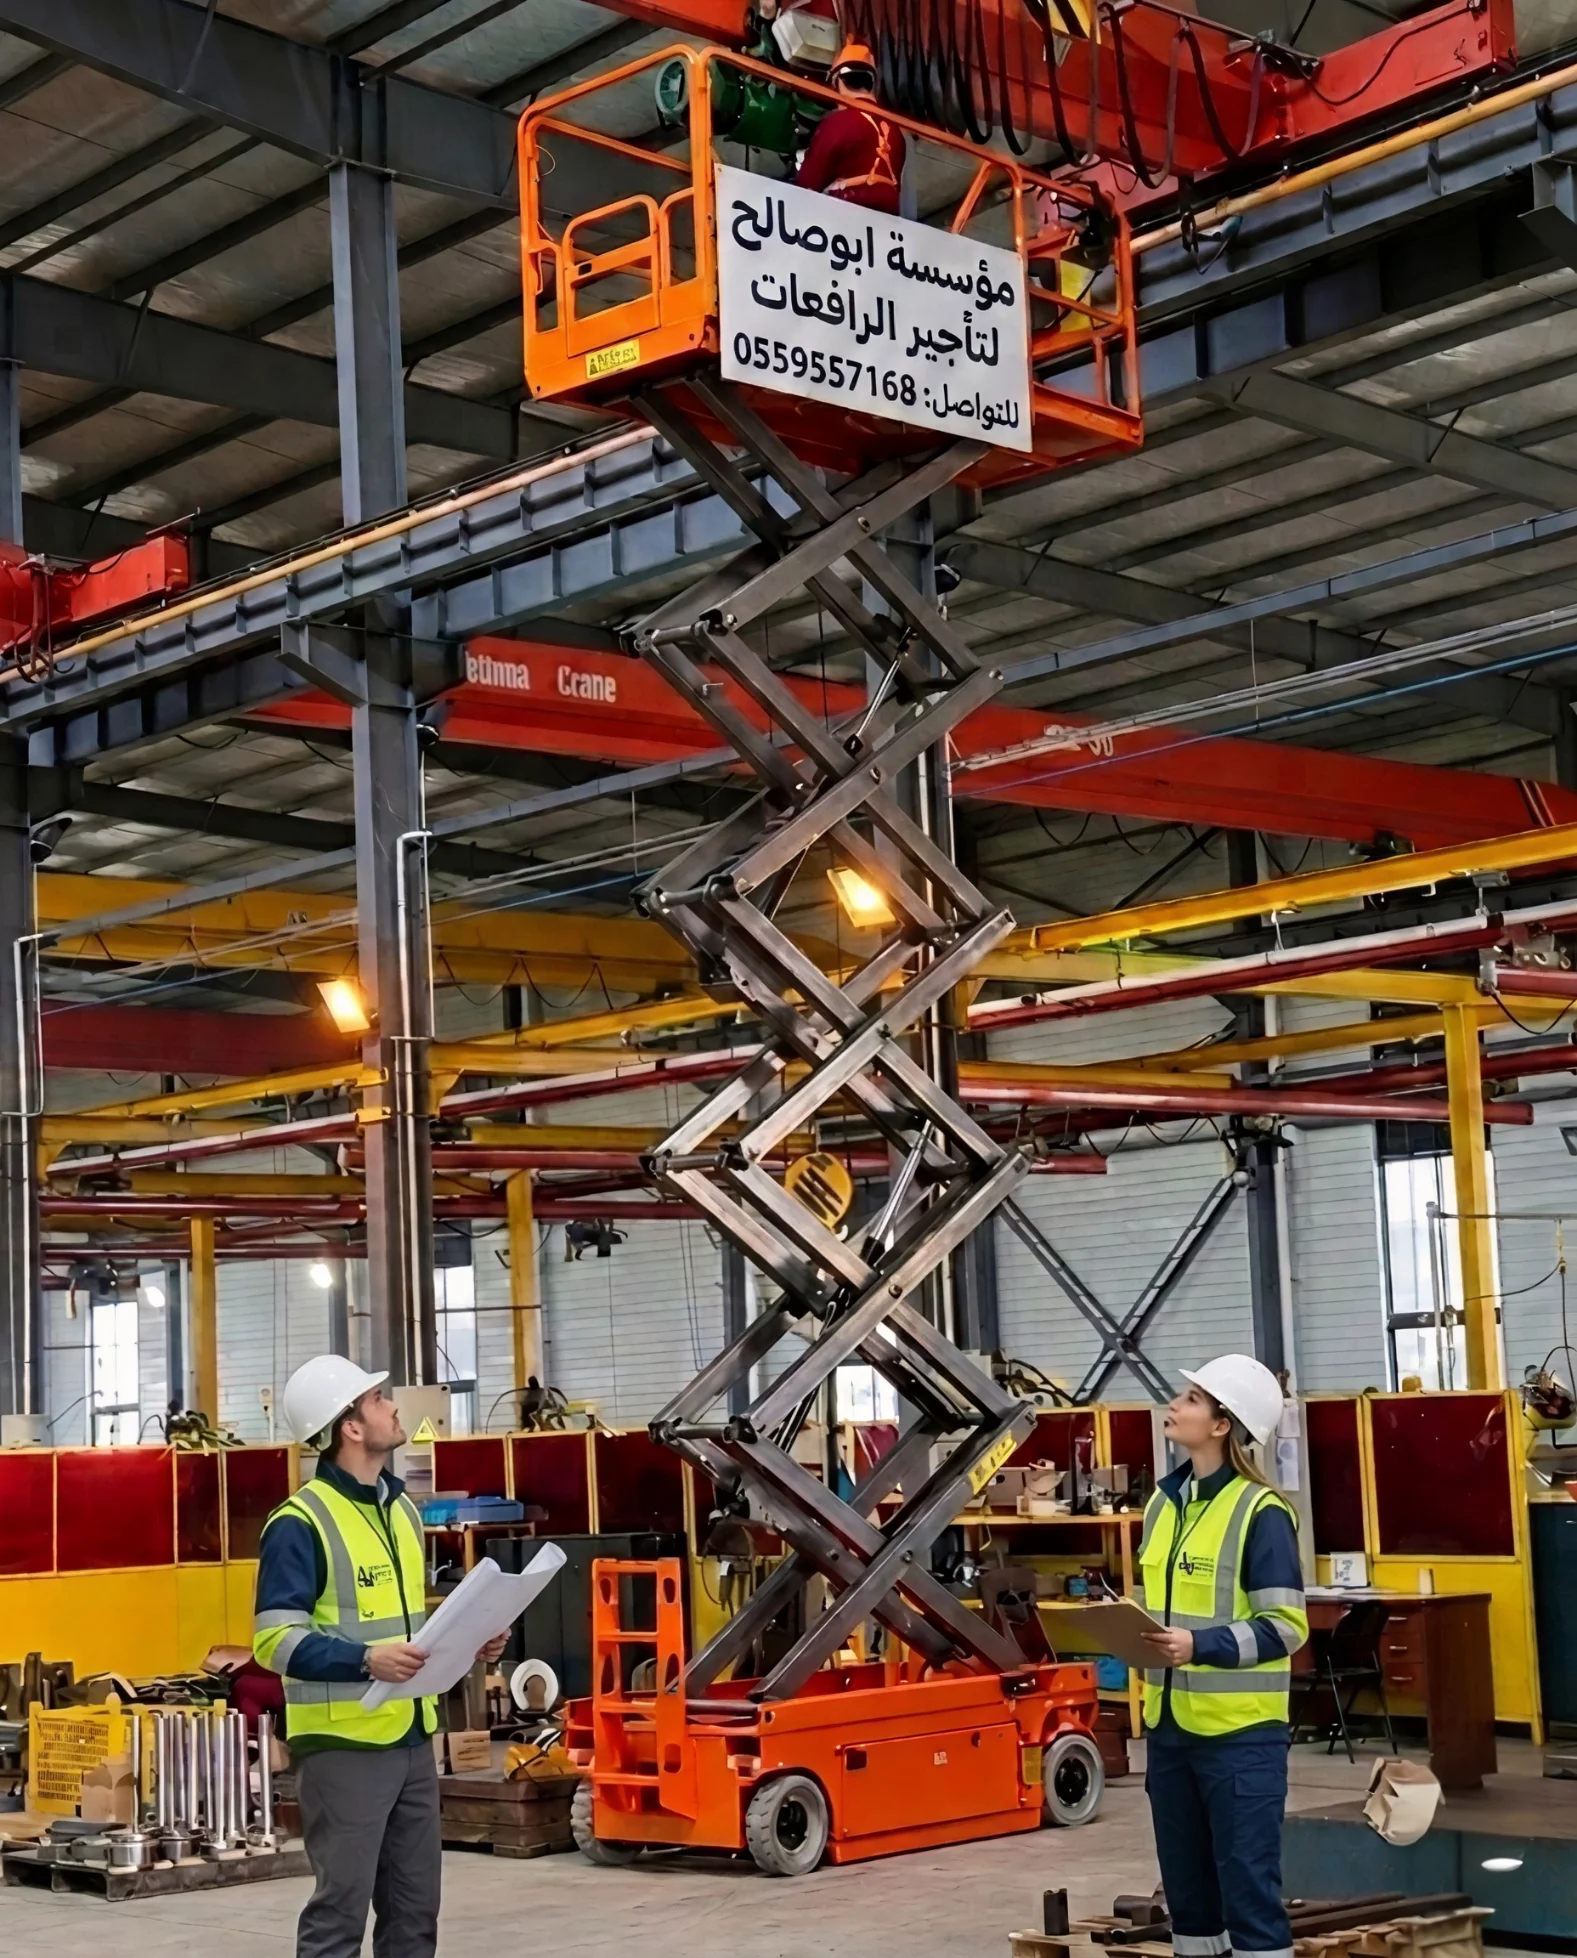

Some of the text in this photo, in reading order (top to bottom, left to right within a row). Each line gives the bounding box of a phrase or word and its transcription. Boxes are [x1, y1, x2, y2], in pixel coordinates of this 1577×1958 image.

[886, 230, 1015, 311] مؤسسة
[750, 272, 999, 367] لتأجير الرافعات
[733, 332, 1019, 431] للتواصل: 0559557168
[557, 664, 617, 703] Crane
